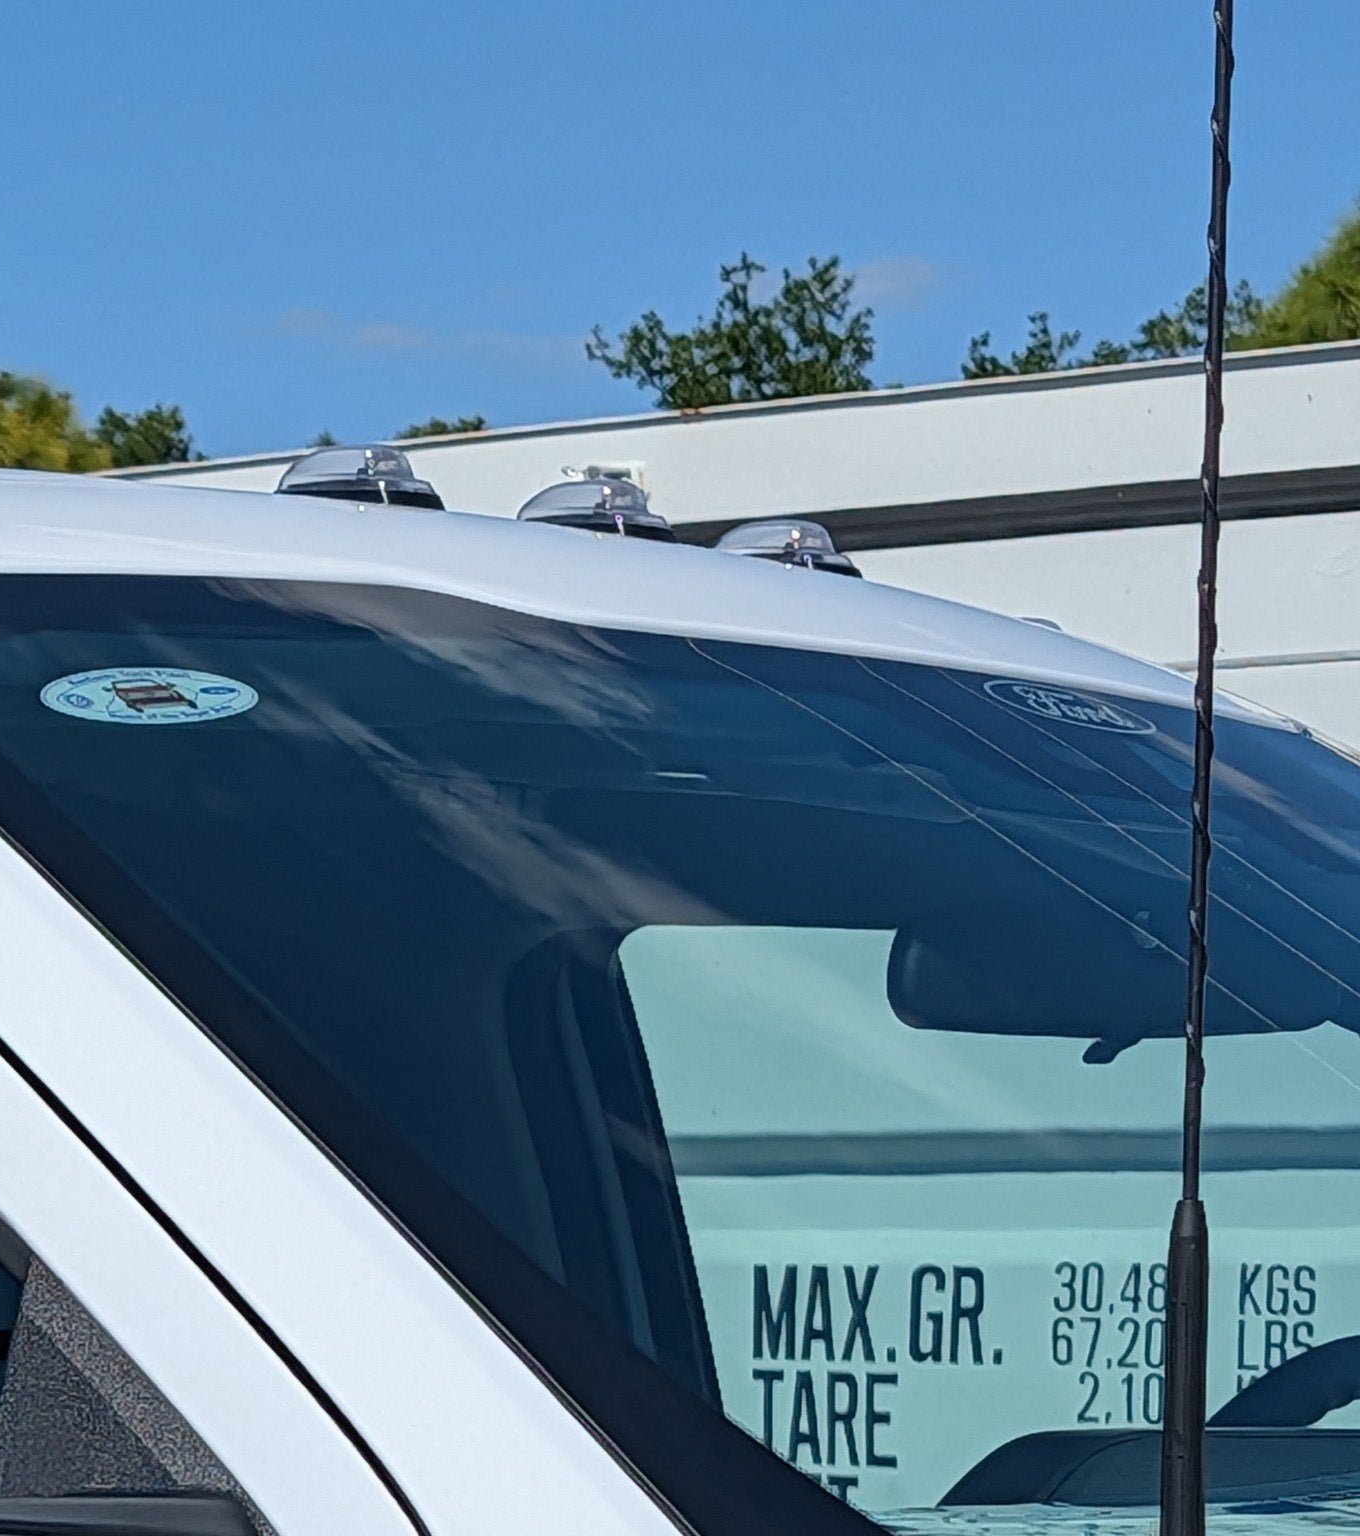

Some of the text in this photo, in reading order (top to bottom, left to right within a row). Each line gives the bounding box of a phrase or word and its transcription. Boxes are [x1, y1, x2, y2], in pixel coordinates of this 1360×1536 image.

[1012, 685, 1135, 729] Ford
[1053, 1261, 1170, 1316] 30,48
[1238, 1262, 1317, 1317] KGS
[1051, 1316, 1167, 1370] 67,20
[751, 1368, 1165, 1468] TARE 2,10
